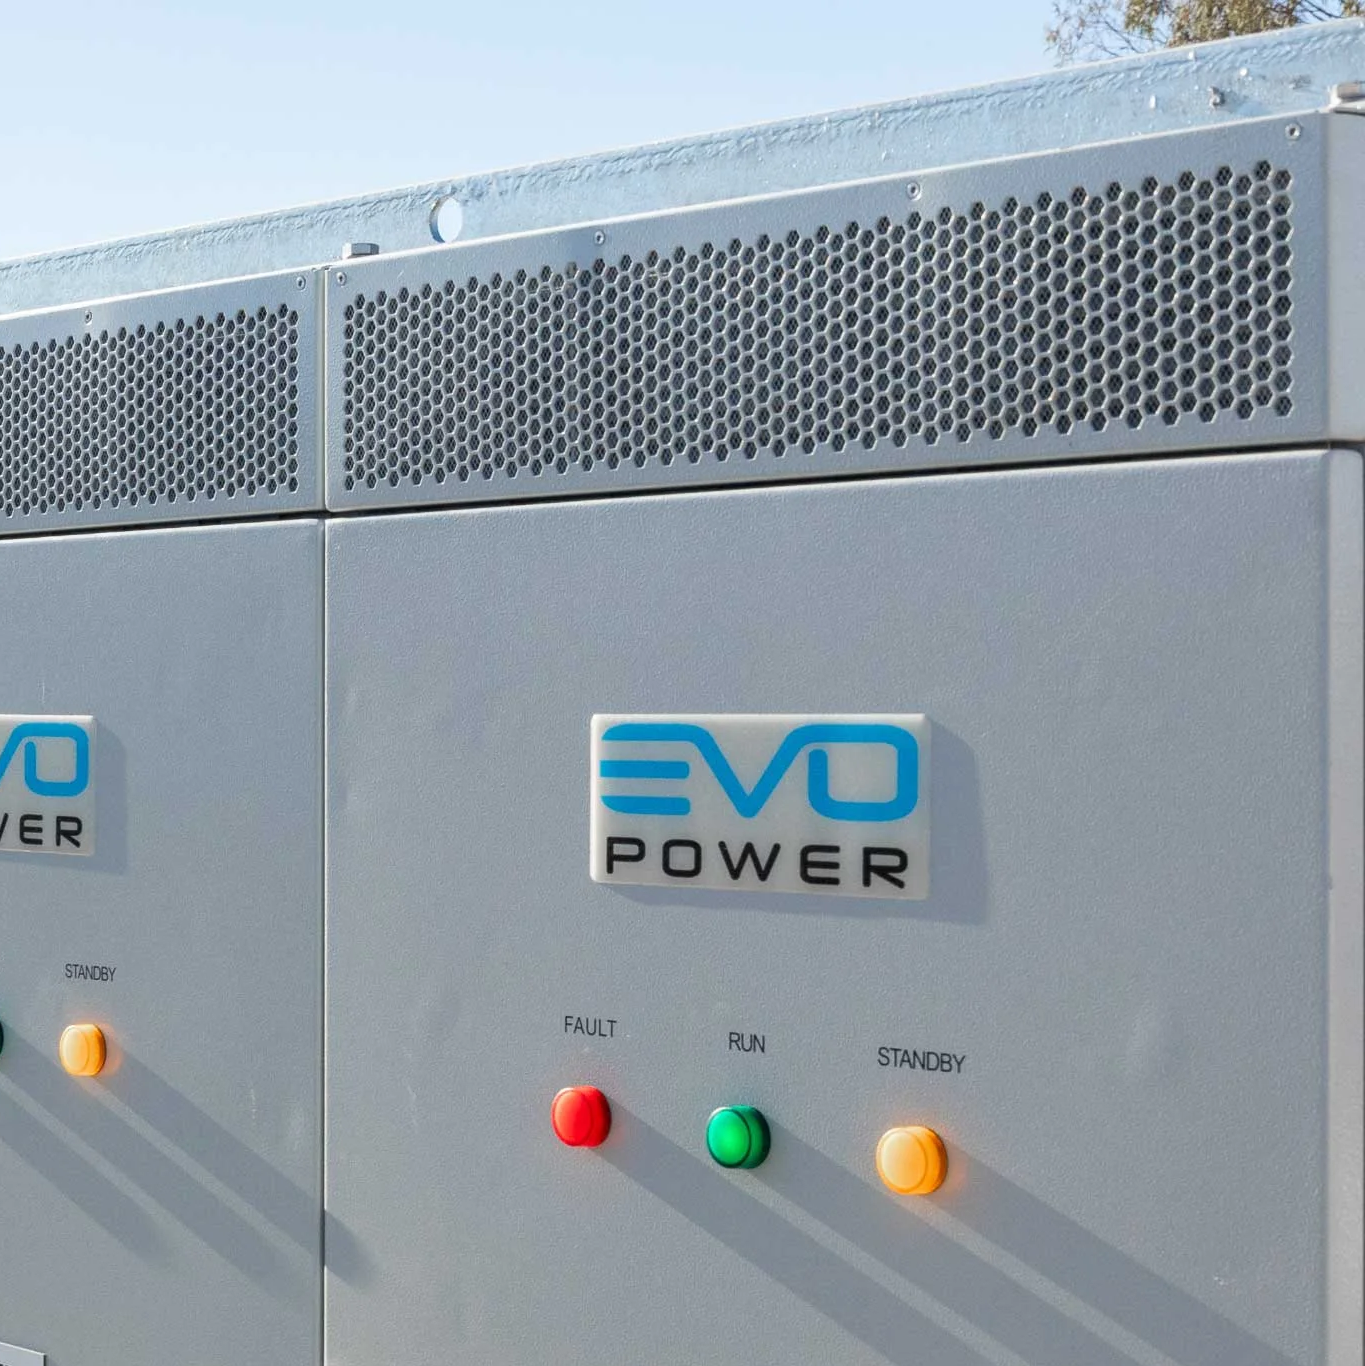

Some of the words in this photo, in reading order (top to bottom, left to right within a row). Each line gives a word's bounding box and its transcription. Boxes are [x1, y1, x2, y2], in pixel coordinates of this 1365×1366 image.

[599, 723, 919, 822] EVO
[606, 836, 909, 889] POWER
[64, 963, 117, 982] STANDBY
[564, 1015, 617, 1038] FAULT
[728, 1031, 766, 1053] RUN
[877, 1046, 966, 1074] STANDBY
